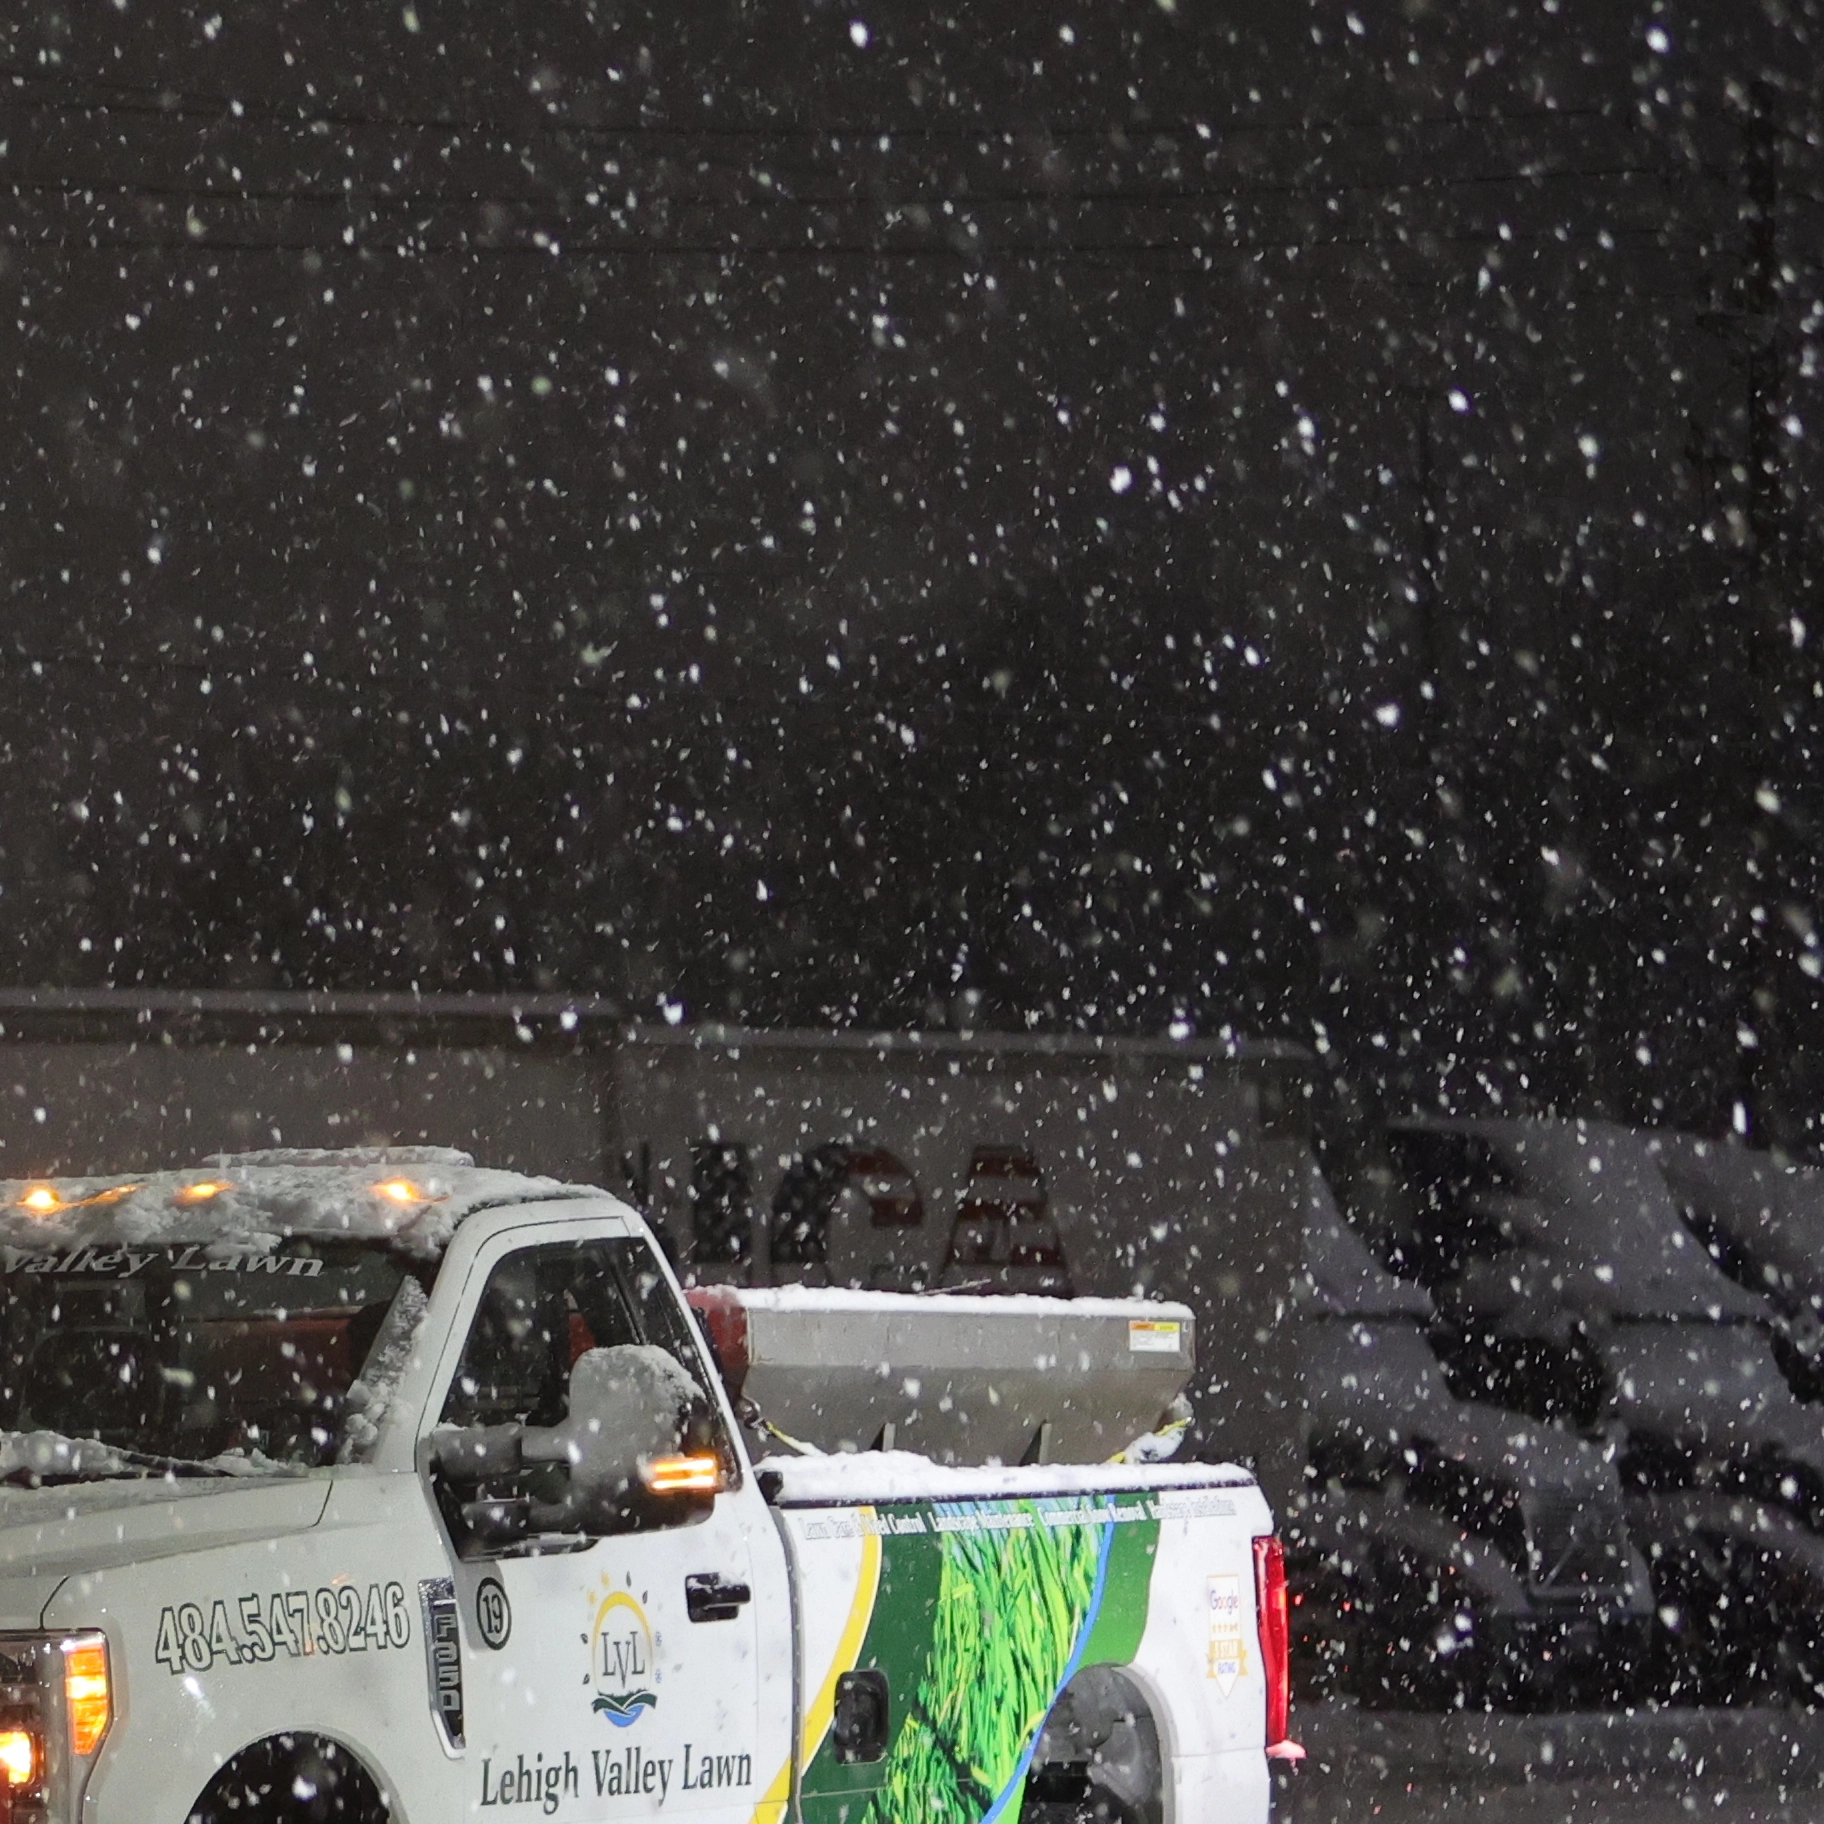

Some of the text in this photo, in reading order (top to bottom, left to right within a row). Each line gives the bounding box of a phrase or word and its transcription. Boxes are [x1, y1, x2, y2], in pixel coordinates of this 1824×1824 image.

[155, 1581, 410, 1675] 484.547.8246
[483, 1593, 503, 1634] 19
[480, 1743, 752, 1815] Lehigh Valley Lawn
